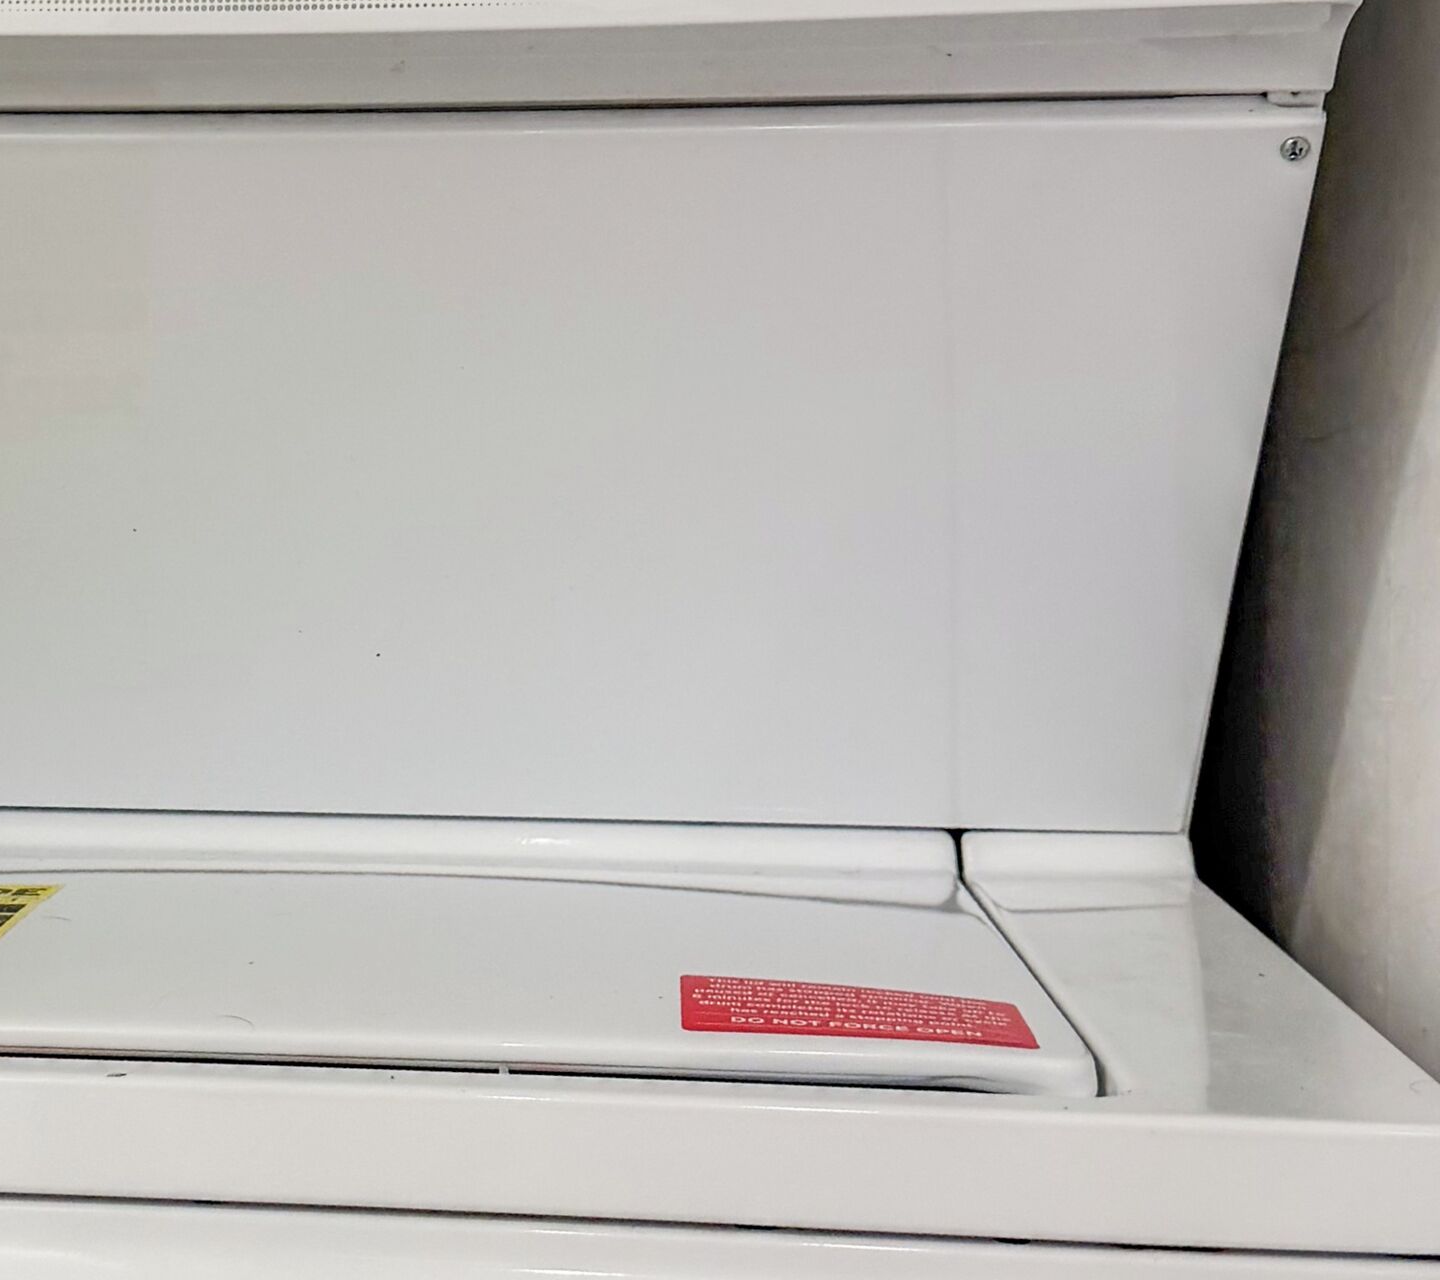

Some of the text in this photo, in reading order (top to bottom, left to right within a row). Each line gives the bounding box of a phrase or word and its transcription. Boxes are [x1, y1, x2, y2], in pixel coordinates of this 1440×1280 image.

[731, 1016, 983, 1037] DO NOT FORCE OPEN
